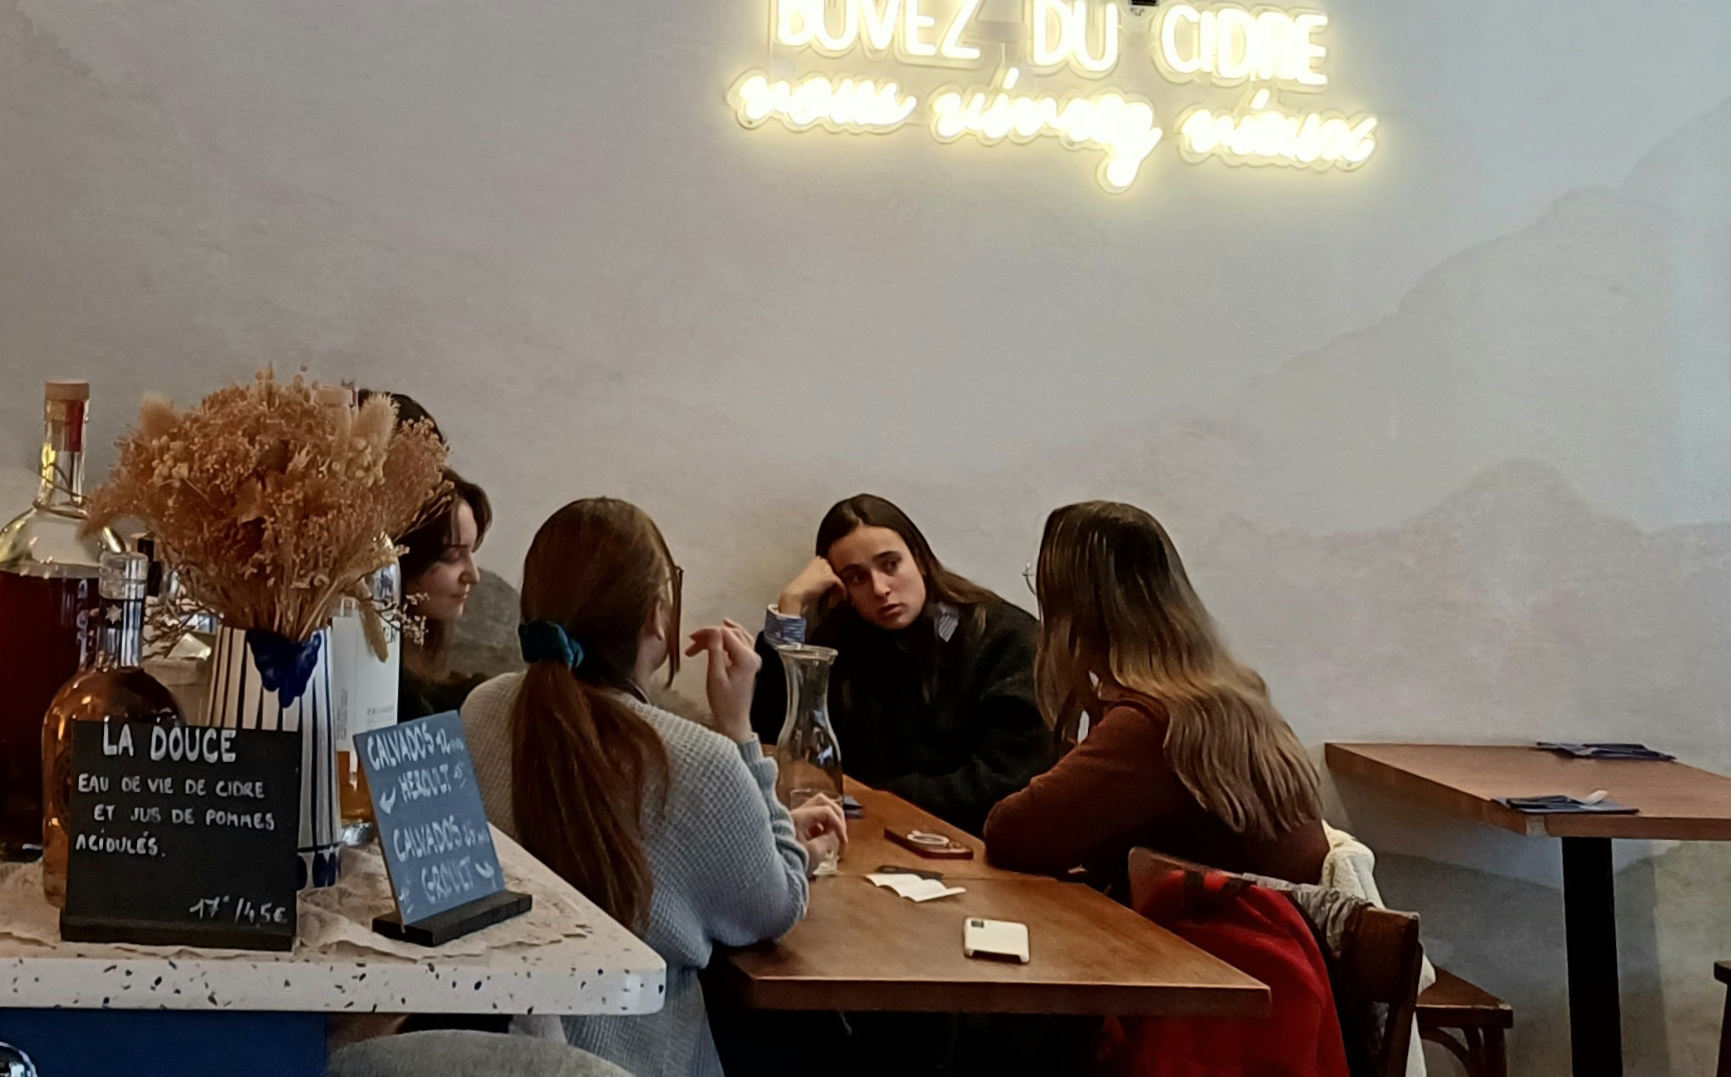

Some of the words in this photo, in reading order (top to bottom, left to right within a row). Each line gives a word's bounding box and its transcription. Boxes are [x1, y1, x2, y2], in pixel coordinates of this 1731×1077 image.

[1160, 4, 1328, 86] CIDRE
[103, 721, 135, 757] LA
[150, 724, 238, 764] DOUCE
[366, 721, 436, 772] CALVADOS
[78, 773, 110, 794] EAU
[122, 775, 142, 794] DE
[147, 777, 174, 795] VIE
[185, 778, 207, 797] DE
[215, 780, 266, 799] CIDRE
[94, 803, 116, 822] ET
[130, 806, 162, 824] JUS
[171, 807, 196, 825] DE
[206, 808, 276, 832] POMMES
[393, 814, 463, 863] CALVADOS
